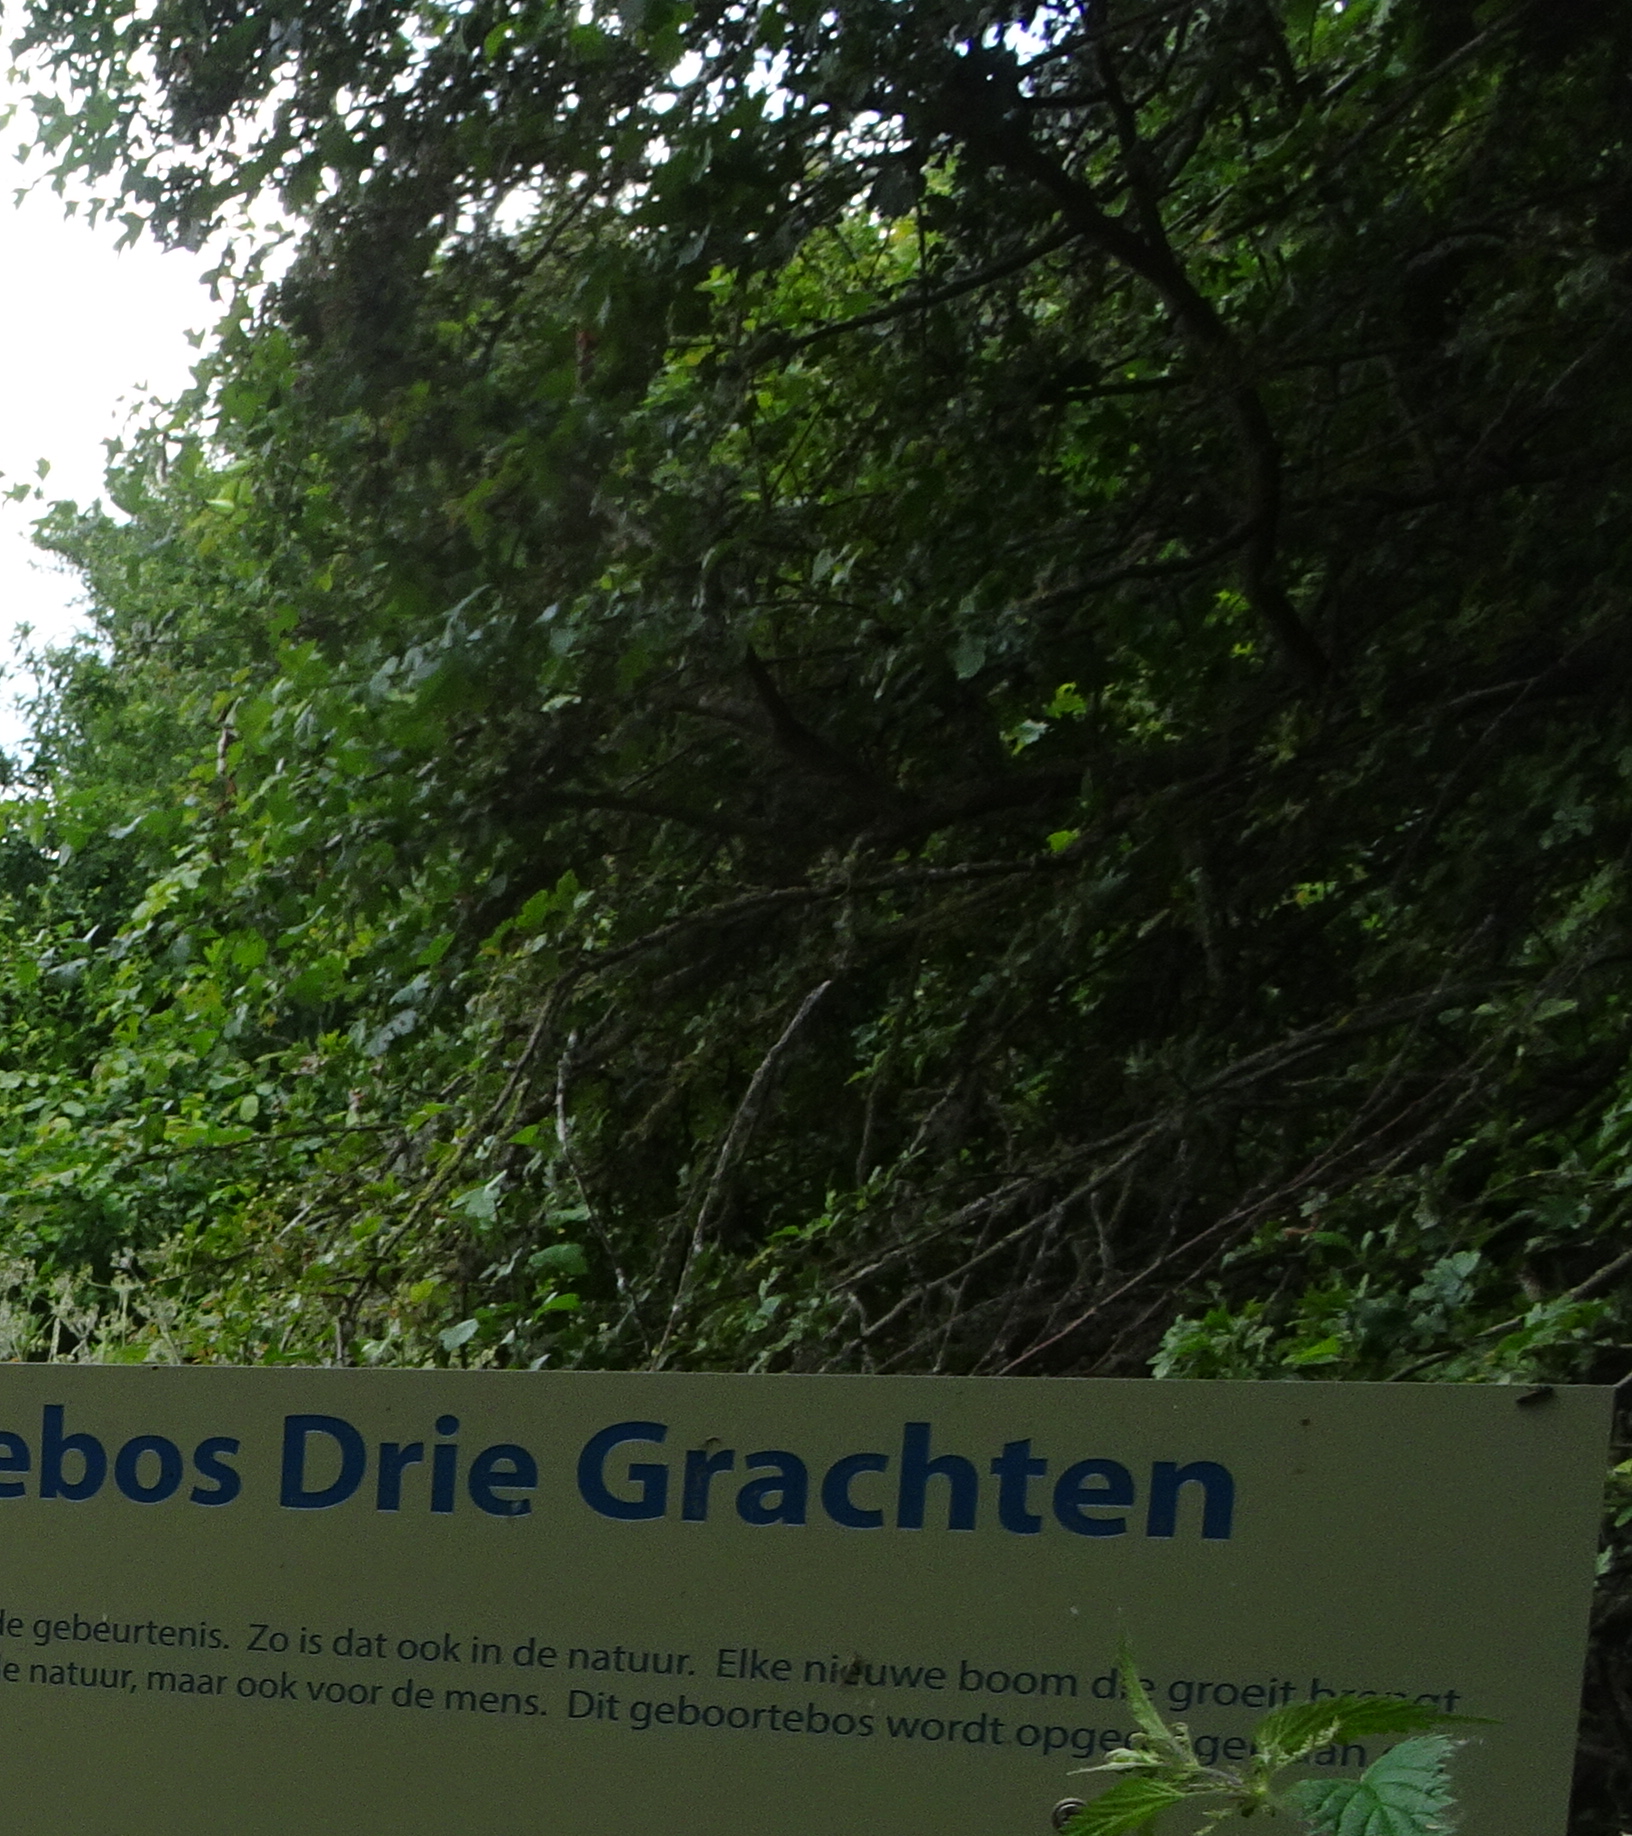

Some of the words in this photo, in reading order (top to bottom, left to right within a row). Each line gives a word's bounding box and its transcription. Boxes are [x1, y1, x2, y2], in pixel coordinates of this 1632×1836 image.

[280, 1415, 537, 1516] Drie
[577, 1421, 1234, 1539] Grachten
[30, 1662, 136, 1693] natuur,
[148, 1672, 227, 1694] maar
[237, 1671, 297, 1699] ook
[307, 1682, 383, 1704] voor
[392, 1679, 434, 1708] de
[446, 1690, 546, 1715] mens.
[568, 1690, 619, 1720] Dit
[630, 1695, 873, 1736] geboortebos
[887, 1713, 1004, 1745] wordt
[33, 1613, 229, 1649] gebeurtenis.
[247, 1624, 288, 1652] Zo
[300, 1627, 321, 1654] is
[333, 1628, 387, 1658] dat
[397, 1633, 460, 1662] ook
[472, 1636, 501, 1664] in
[513, 1638, 557, 1667] de
[569, 1646, 694, 1675] natuur.
[717, 1648, 792, 1681] Elke
[805, 1655, 946, 1689] nieuwe
[959, 1660, 1076, 1696] boom
[1168, 1678, 1296, 1712] groeit
